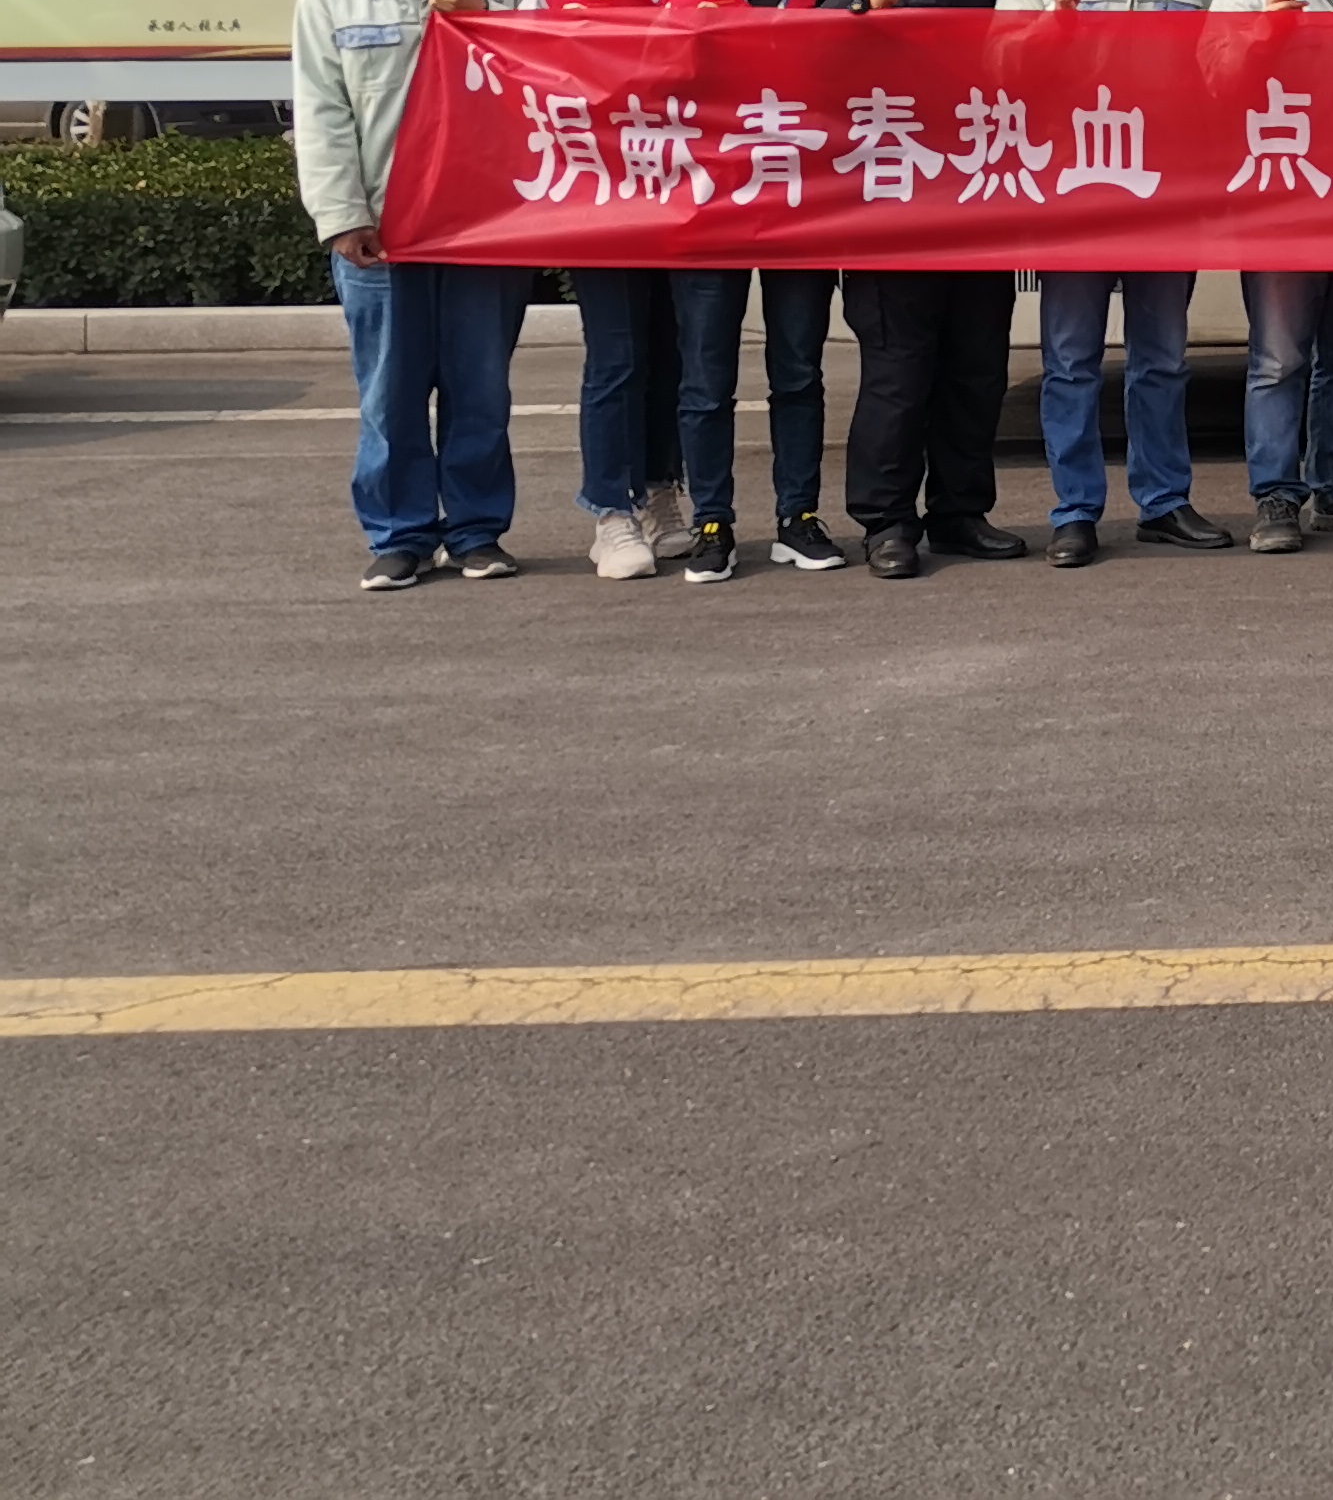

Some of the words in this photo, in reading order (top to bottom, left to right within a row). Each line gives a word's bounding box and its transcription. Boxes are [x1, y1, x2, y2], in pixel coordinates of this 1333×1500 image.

[465, 43, 1161, 207] “捐献青春热血
